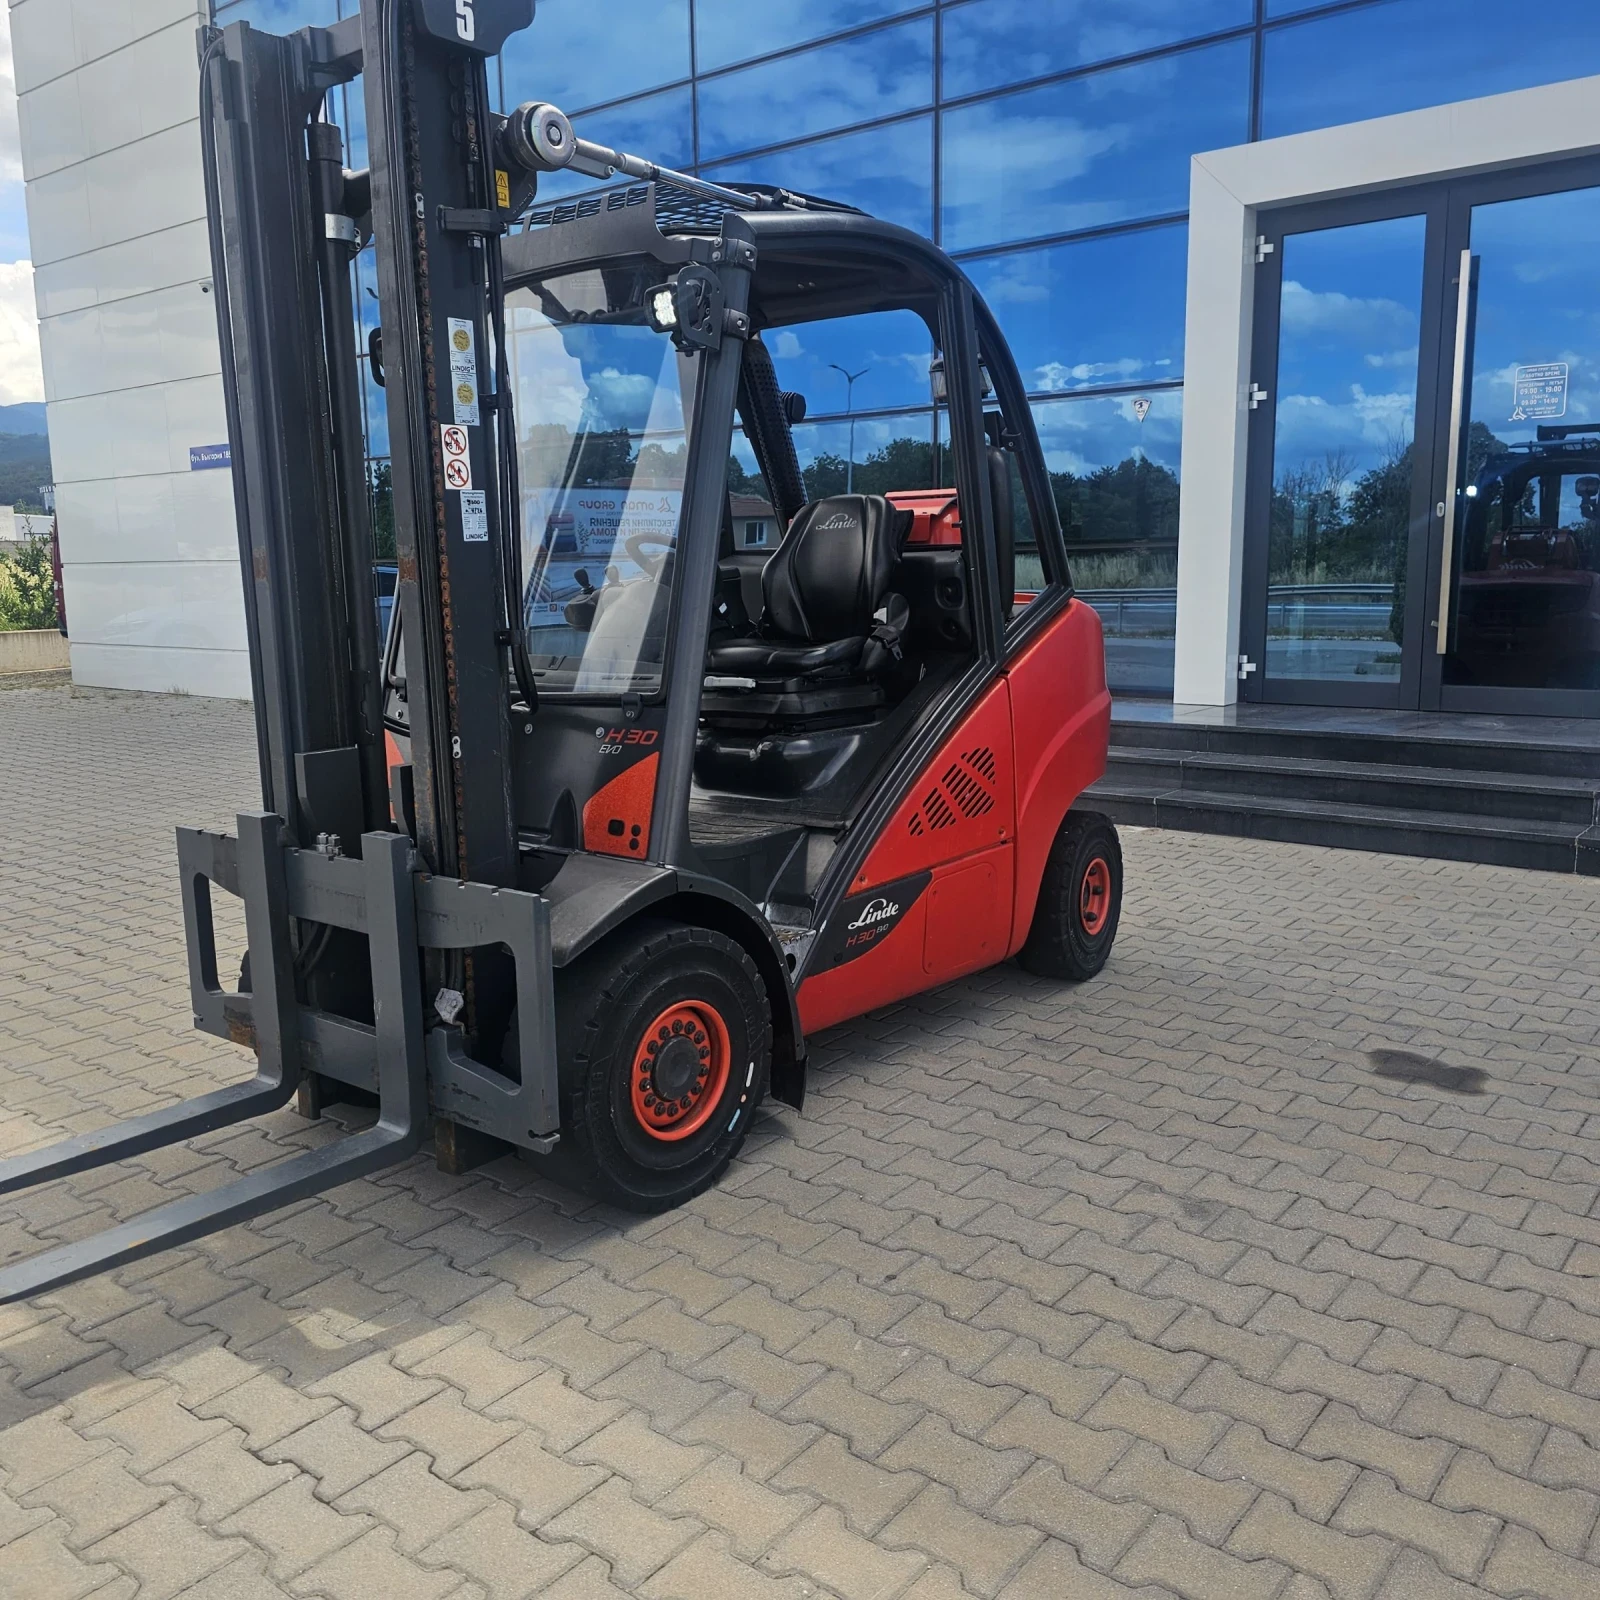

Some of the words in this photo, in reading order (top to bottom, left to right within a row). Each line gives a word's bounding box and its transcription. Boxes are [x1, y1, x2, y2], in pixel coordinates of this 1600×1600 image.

[452, 364, 470, 373] LINDIG
[815, 512, 858, 530] Linde
[598, 744, 622, 754] EVO
[847, 898, 899, 930] Linde
